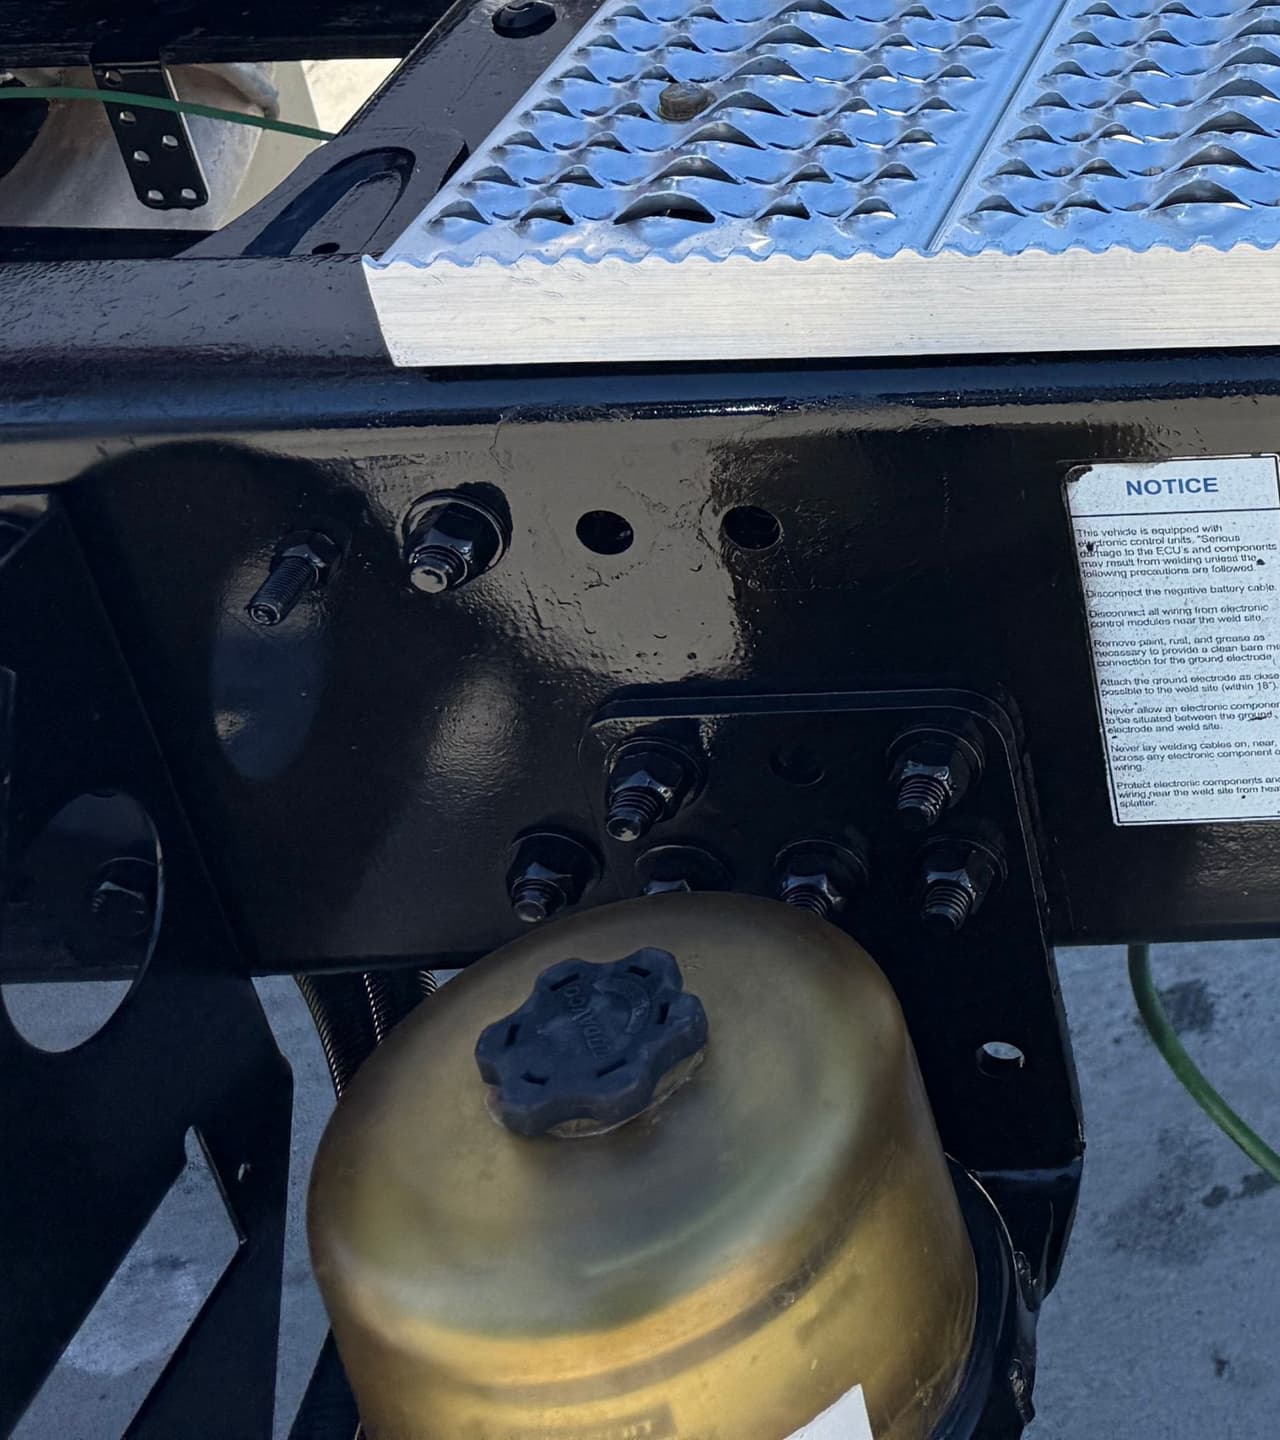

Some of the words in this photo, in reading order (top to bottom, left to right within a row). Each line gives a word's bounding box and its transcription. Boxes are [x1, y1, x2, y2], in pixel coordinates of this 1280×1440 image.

[1126, 477, 1219, 496] NOTICE
[1077, 528, 1098, 536] This
[1101, 527, 1136, 535] vehicle
[1150, 525, 1199, 536] equipped
[1201, 524, 1222, 532] with
[1078, 537, 1127, 546] elctronic
[1129, 536, 1164, 545] control
[1079, 548, 1122, 558] damage
[1124, 547, 1134, 555] to
[1137, 547, 1153, 555] the
[1155, 546, 1189, 554] ECU's
[1191, 545, 1211, 553] and
[1214, 543, 1277, 554] components
[1081, 560, 1103, 568] may
[1105, 557, 1134, 566] result
[1136, 557, 1160, 565] from
[1163, 555, 1202, 566] welding
[1204, 554, 1238, 563] unless
[1082, 568, 1127, 578] following
[1129, 566, 1189, 577] precautions
[1085, 588, 1141, 597] Disconnect
[1145, 587, 1160, 595] the
[1164, 586, 1207, 596] negative
[1209, 585, 1244, 595] battery
[1088, 608, 1145, 617] Disconnect
[1147, 607, 1159, 615] all
[1161, 606, 1192, 616] wiring
[1194, 605, 1218, 613] from
[1220, 604, 1269, 612] electronic
[1089, 619, 1124, 627] control
[1127, 617, 1170, 626] modules
[1217, 615, 1241, 623] weld
[1093, 638, 1136, 646] Remove
[1193, 635, 1212, 643] and
[1215, 636, 1250, 644] grease
[1094, 649, 1147, 658] necessary
[1161, 646, 1198, 656] provide
[1210, 644, 1237, 652] clean
[1240, 643, 1263, 651] bare
[1095, 657, 1150, 666] connection
[1169, 656, 1185, 664] the
[1187, 655, 1223, 665] ground
[1099, 677, 1131, 686] Attach
[1152, 675, 1187, 685] ground
[1190, 674, 1236, 682] electrode
[1253, 672, 1279, 680] close
[1100, 687, 1142, 697] possible
[1157, 685, 1172, 693] the
[1221, 683, 1253, 693] (within
[1104, 706, 1134, 714] Never
[1136, 705, 1162, 713] allow
[1180, 703, 1227, 711] electronic
[1118, 716, 1130, 724] be
[1132, 715, 1172, 723] situated
[1174, 713, 1217, 721] between
[1219, 712, 1237, 720] the
[1238, 711, 1272, 721] ground
[1107, 725, 1152, 733] electrode
[1176, 723, 1200, 731] weld
[1110, 744, 1139, 752] Never
[1142, 743, 1156, 752] lay
[1158, 742, 1197, 752] welding
[1199, 740, 1231, 749] cables
[1146, 754, 1164, 762] any
[1167, 750, 1214, 759] electronic
[1216, 748, 1272, 759] component
[1116, 780, 1151, 789] Protect
[1153, 778, 1200, 787] electronic
[1202, 776, 1263, 787] components
[1118, 789, 1146, 799] wiring
[1236, 785, 1258, 793] from
